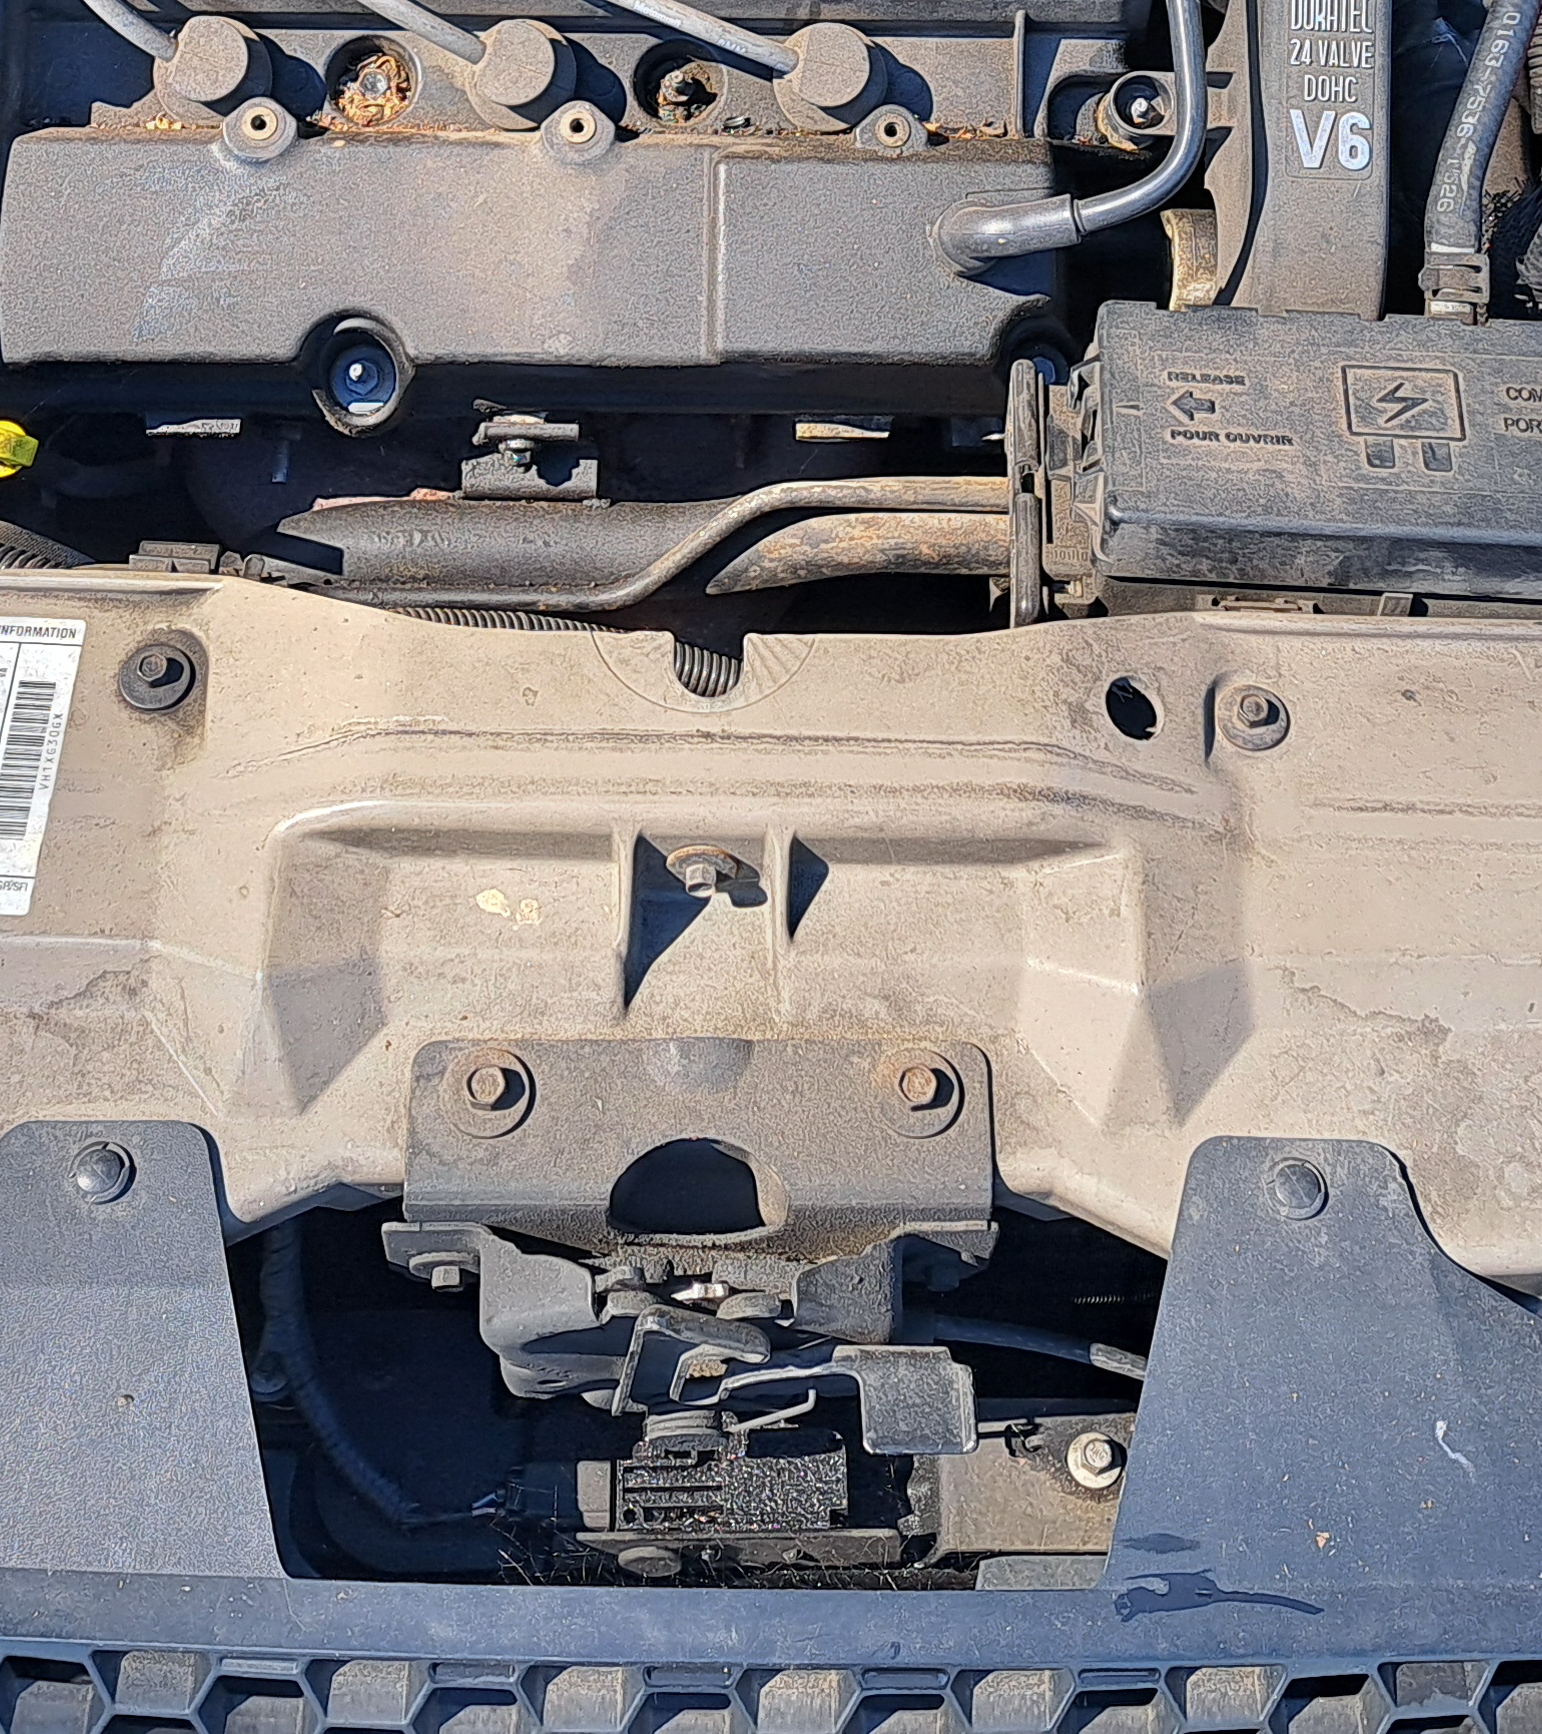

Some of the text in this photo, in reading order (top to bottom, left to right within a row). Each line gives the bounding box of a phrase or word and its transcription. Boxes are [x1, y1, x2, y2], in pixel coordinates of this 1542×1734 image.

[1290, 38, 1373, 69] 24 VALVE
[1304, 74, 1358, 102] DOHC
[1289, 109, 1372, 171] V6
[1167, 370, 1247, 386] RELEASE
[1170, 429, 1295, 447] POUR OUVRIR
